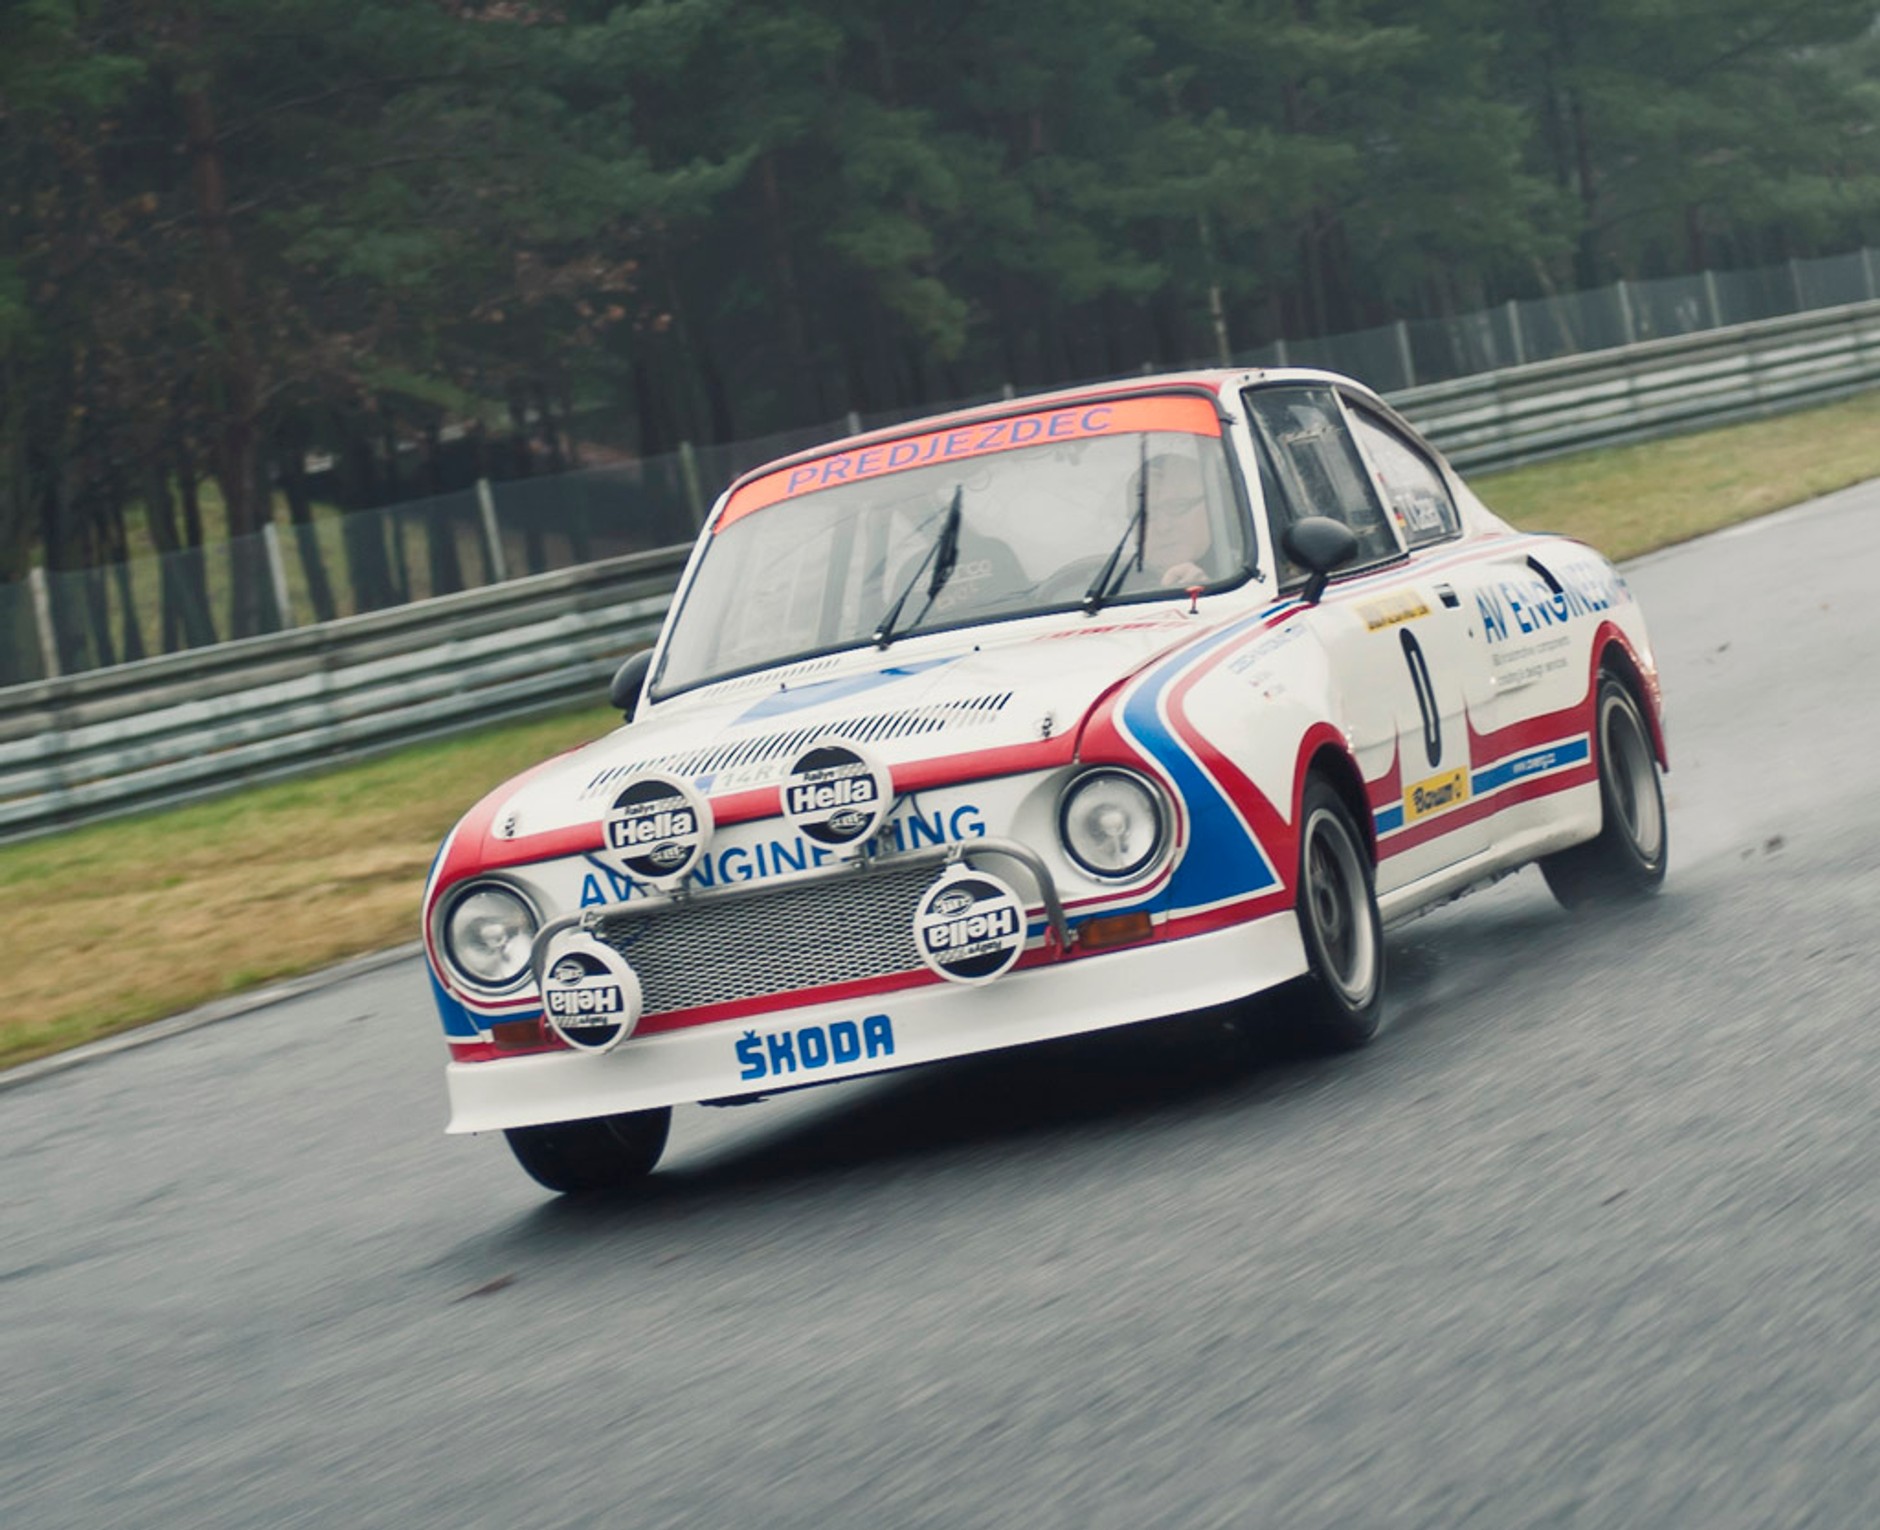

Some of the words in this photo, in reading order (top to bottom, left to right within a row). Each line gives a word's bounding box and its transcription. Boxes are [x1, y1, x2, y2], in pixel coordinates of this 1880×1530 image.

[1474, 586, 1509, 645] AV
[1399, 627, 1442, 768] 0
[792, 779, 872, 813] Hella
[614, 812, 693, 847] Hella
[928, 909, 1013, 948] Hella
[550, 987, 617, 1014] Hella
[734, 1013, 895, 1081] ŠKODA
